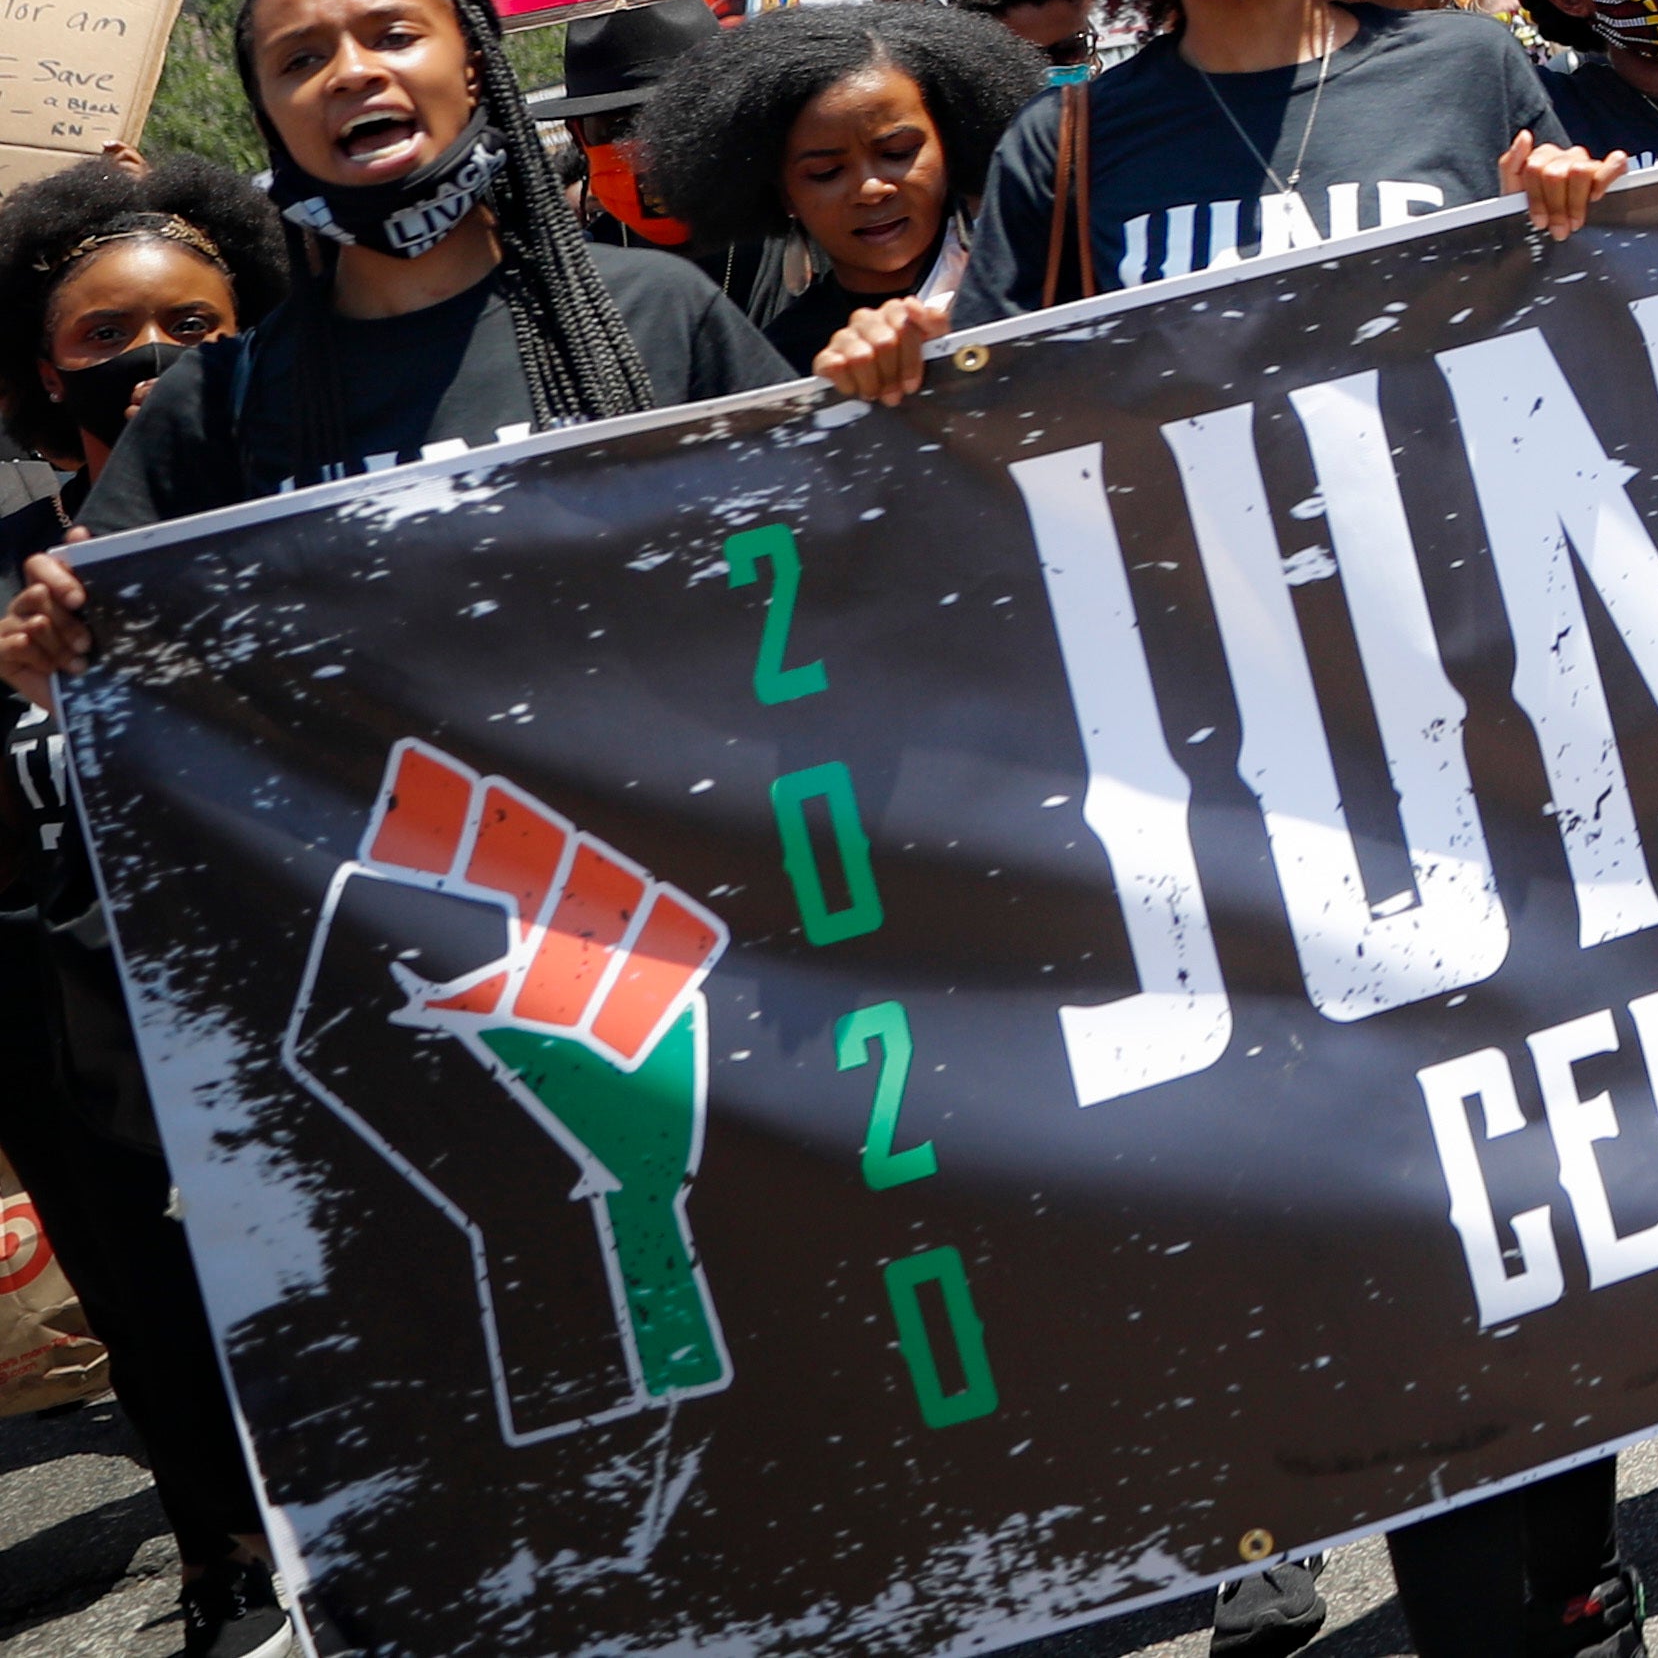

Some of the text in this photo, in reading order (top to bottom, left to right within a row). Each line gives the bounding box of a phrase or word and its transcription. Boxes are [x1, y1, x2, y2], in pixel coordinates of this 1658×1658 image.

[65, 10, 128, 38] am
[32, 59, 115, 93] Save
[67, 97, 120, 117] Black
[724, 522, 999, 1430] 2020
